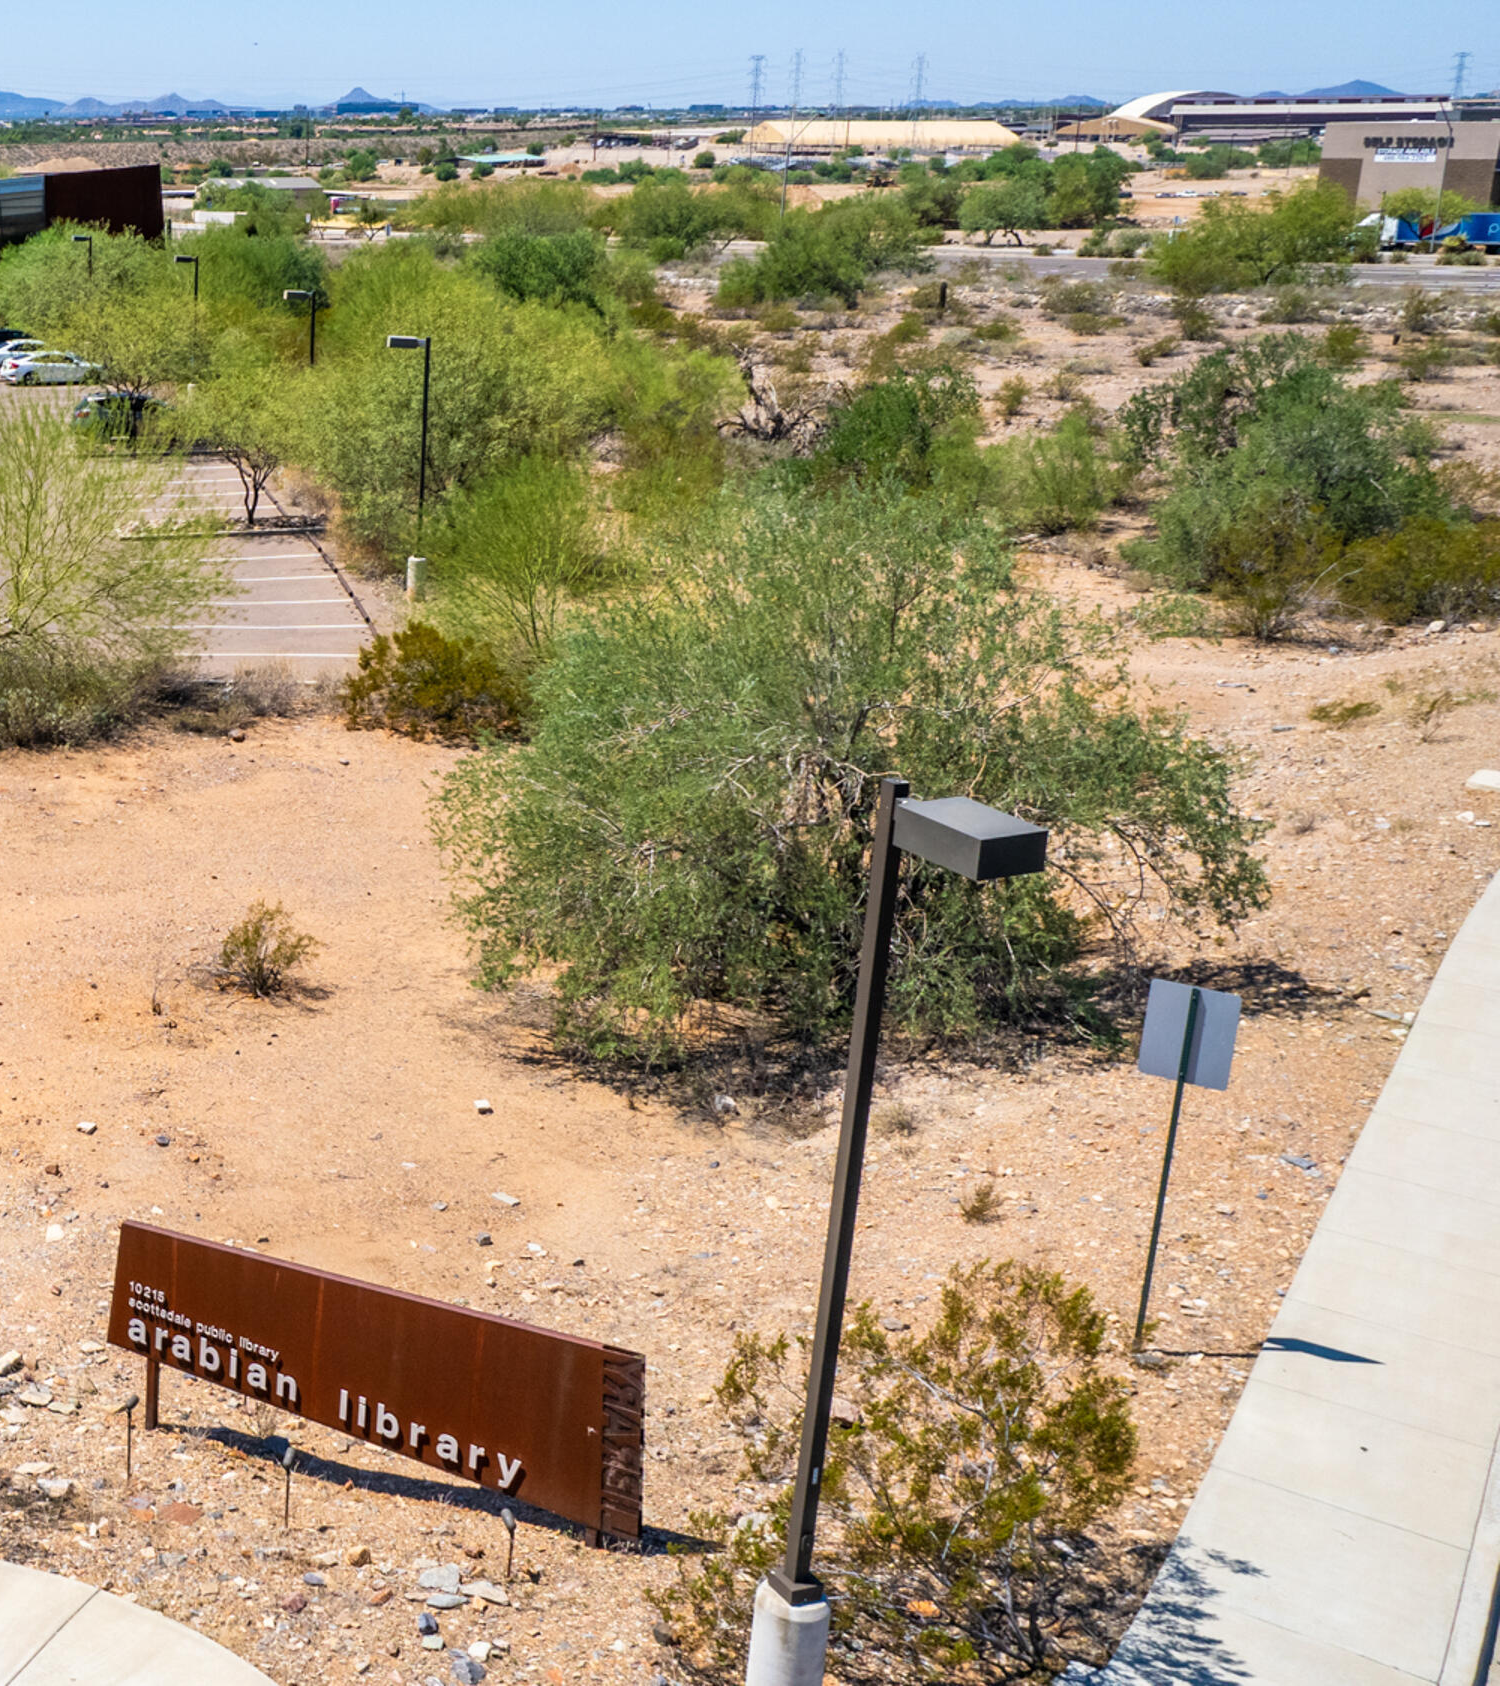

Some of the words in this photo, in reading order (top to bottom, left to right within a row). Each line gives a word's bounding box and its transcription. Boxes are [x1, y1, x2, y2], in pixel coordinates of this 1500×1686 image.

[128, 1280, 165, 1303] 10215
[128, 1296, 192, 1329] scottsdale
[196, 1322, 234, 1344] public
[239, 1335, 280, 1362] library
[127, 1317, 298, 1402] arabian
[338, 1388, 522, 1489] library
